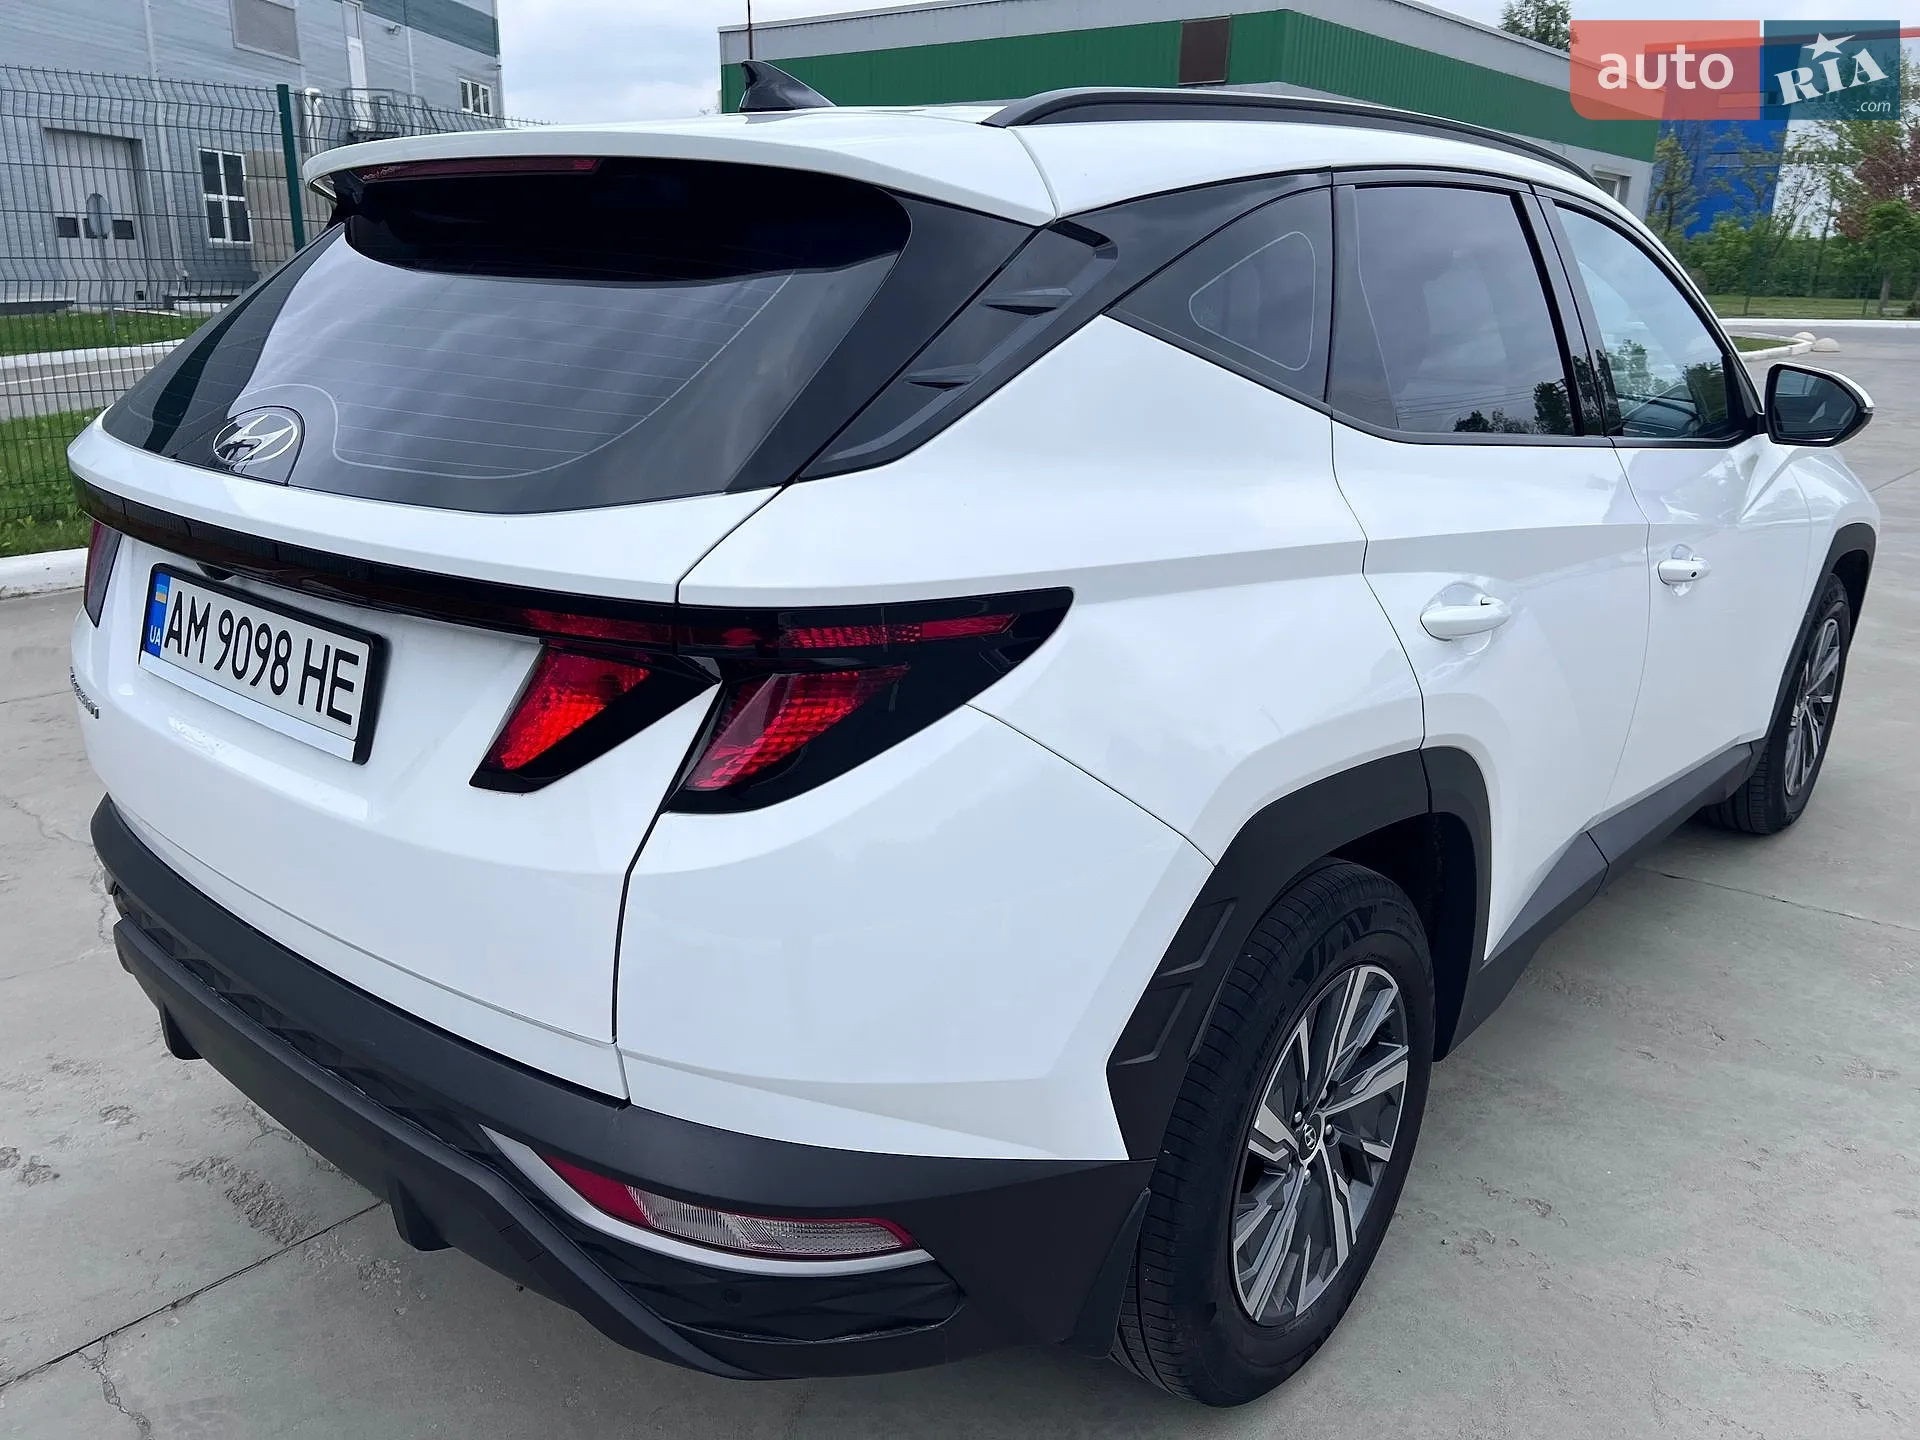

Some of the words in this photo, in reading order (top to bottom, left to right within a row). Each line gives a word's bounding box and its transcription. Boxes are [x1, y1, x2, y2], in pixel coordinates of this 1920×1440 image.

[149, 625, 161, 646] UA
[164, 590, 211, 664] AM
[214, 609, 292, 696] 9098
[298, 638, 360, 726] HE
